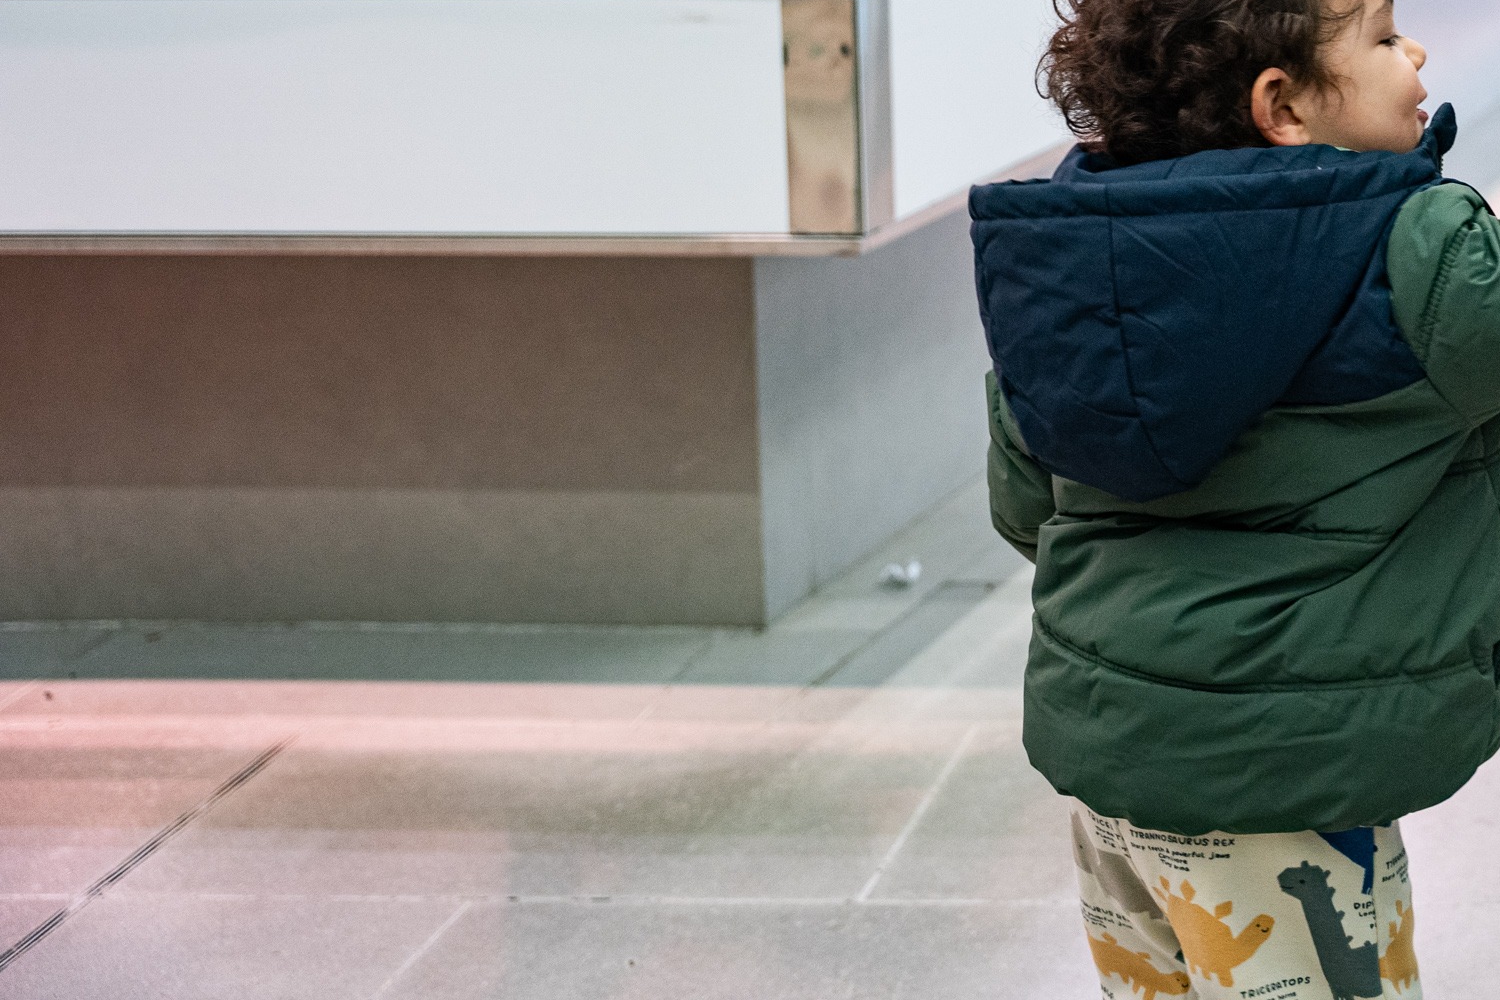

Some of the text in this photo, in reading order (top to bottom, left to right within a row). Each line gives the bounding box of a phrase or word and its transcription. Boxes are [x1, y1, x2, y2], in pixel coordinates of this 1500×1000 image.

[1129, 829, 1209, 846] TYRANNOSAURUS
[1213, 838, 1235, 847] REX
[1240, 976, 1311, 999] TRICERATOPS
